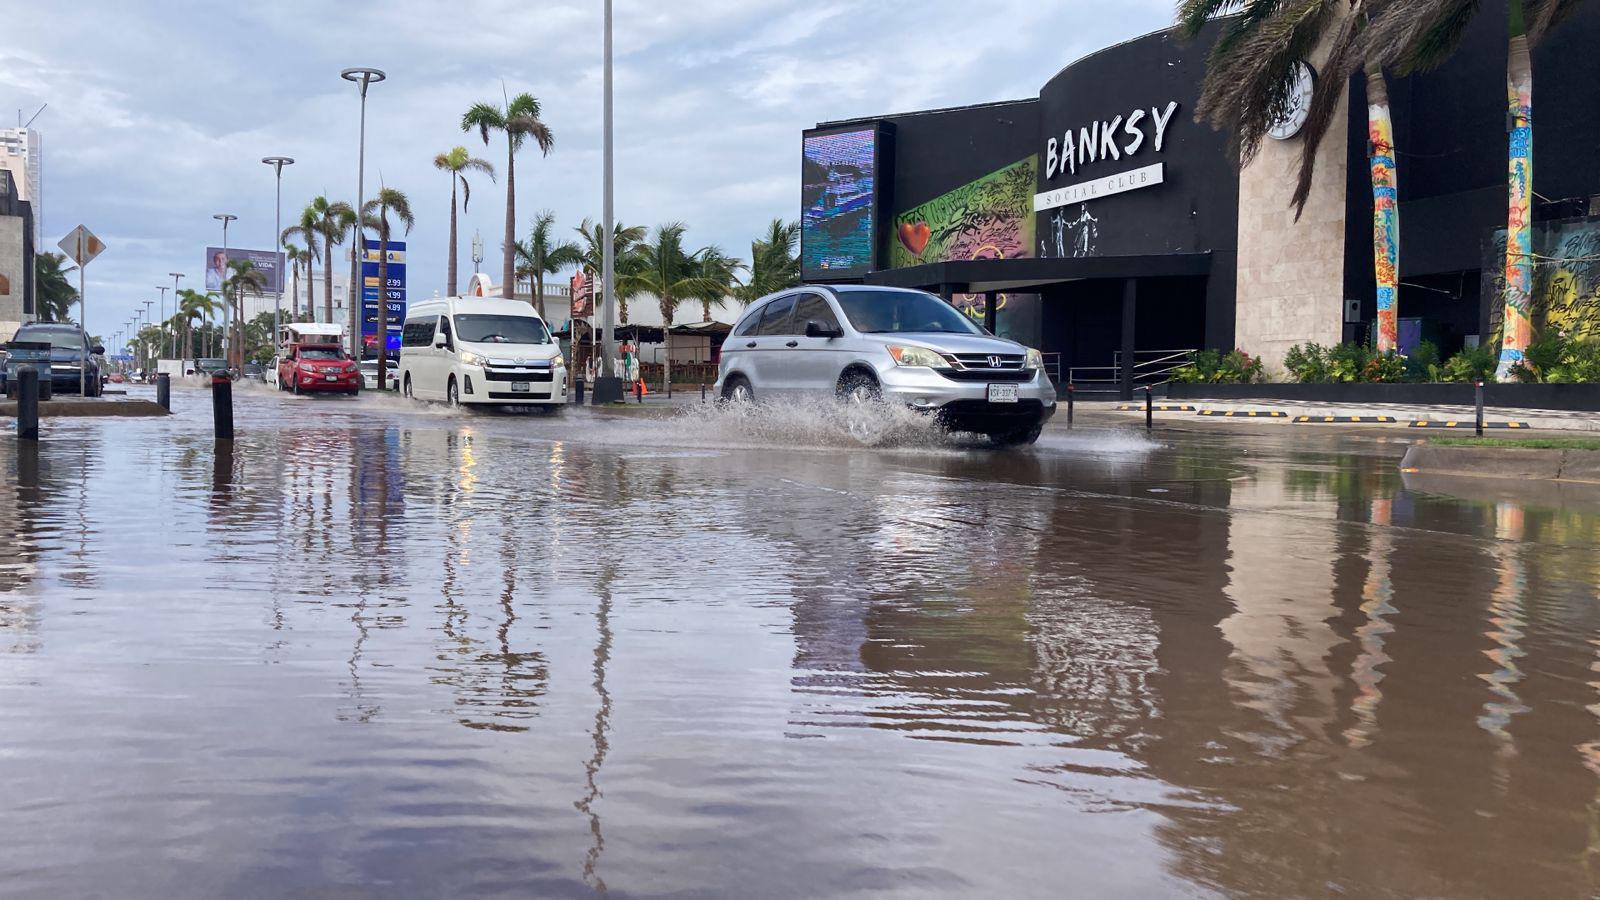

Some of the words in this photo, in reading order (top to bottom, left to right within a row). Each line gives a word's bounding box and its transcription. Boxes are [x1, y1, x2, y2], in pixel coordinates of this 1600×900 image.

[1046, 101, 1178, 180] BANKSY
[1046, 184, 1097, 205] SOCIAL
[1108, 172, 1148, 190] CLUB
